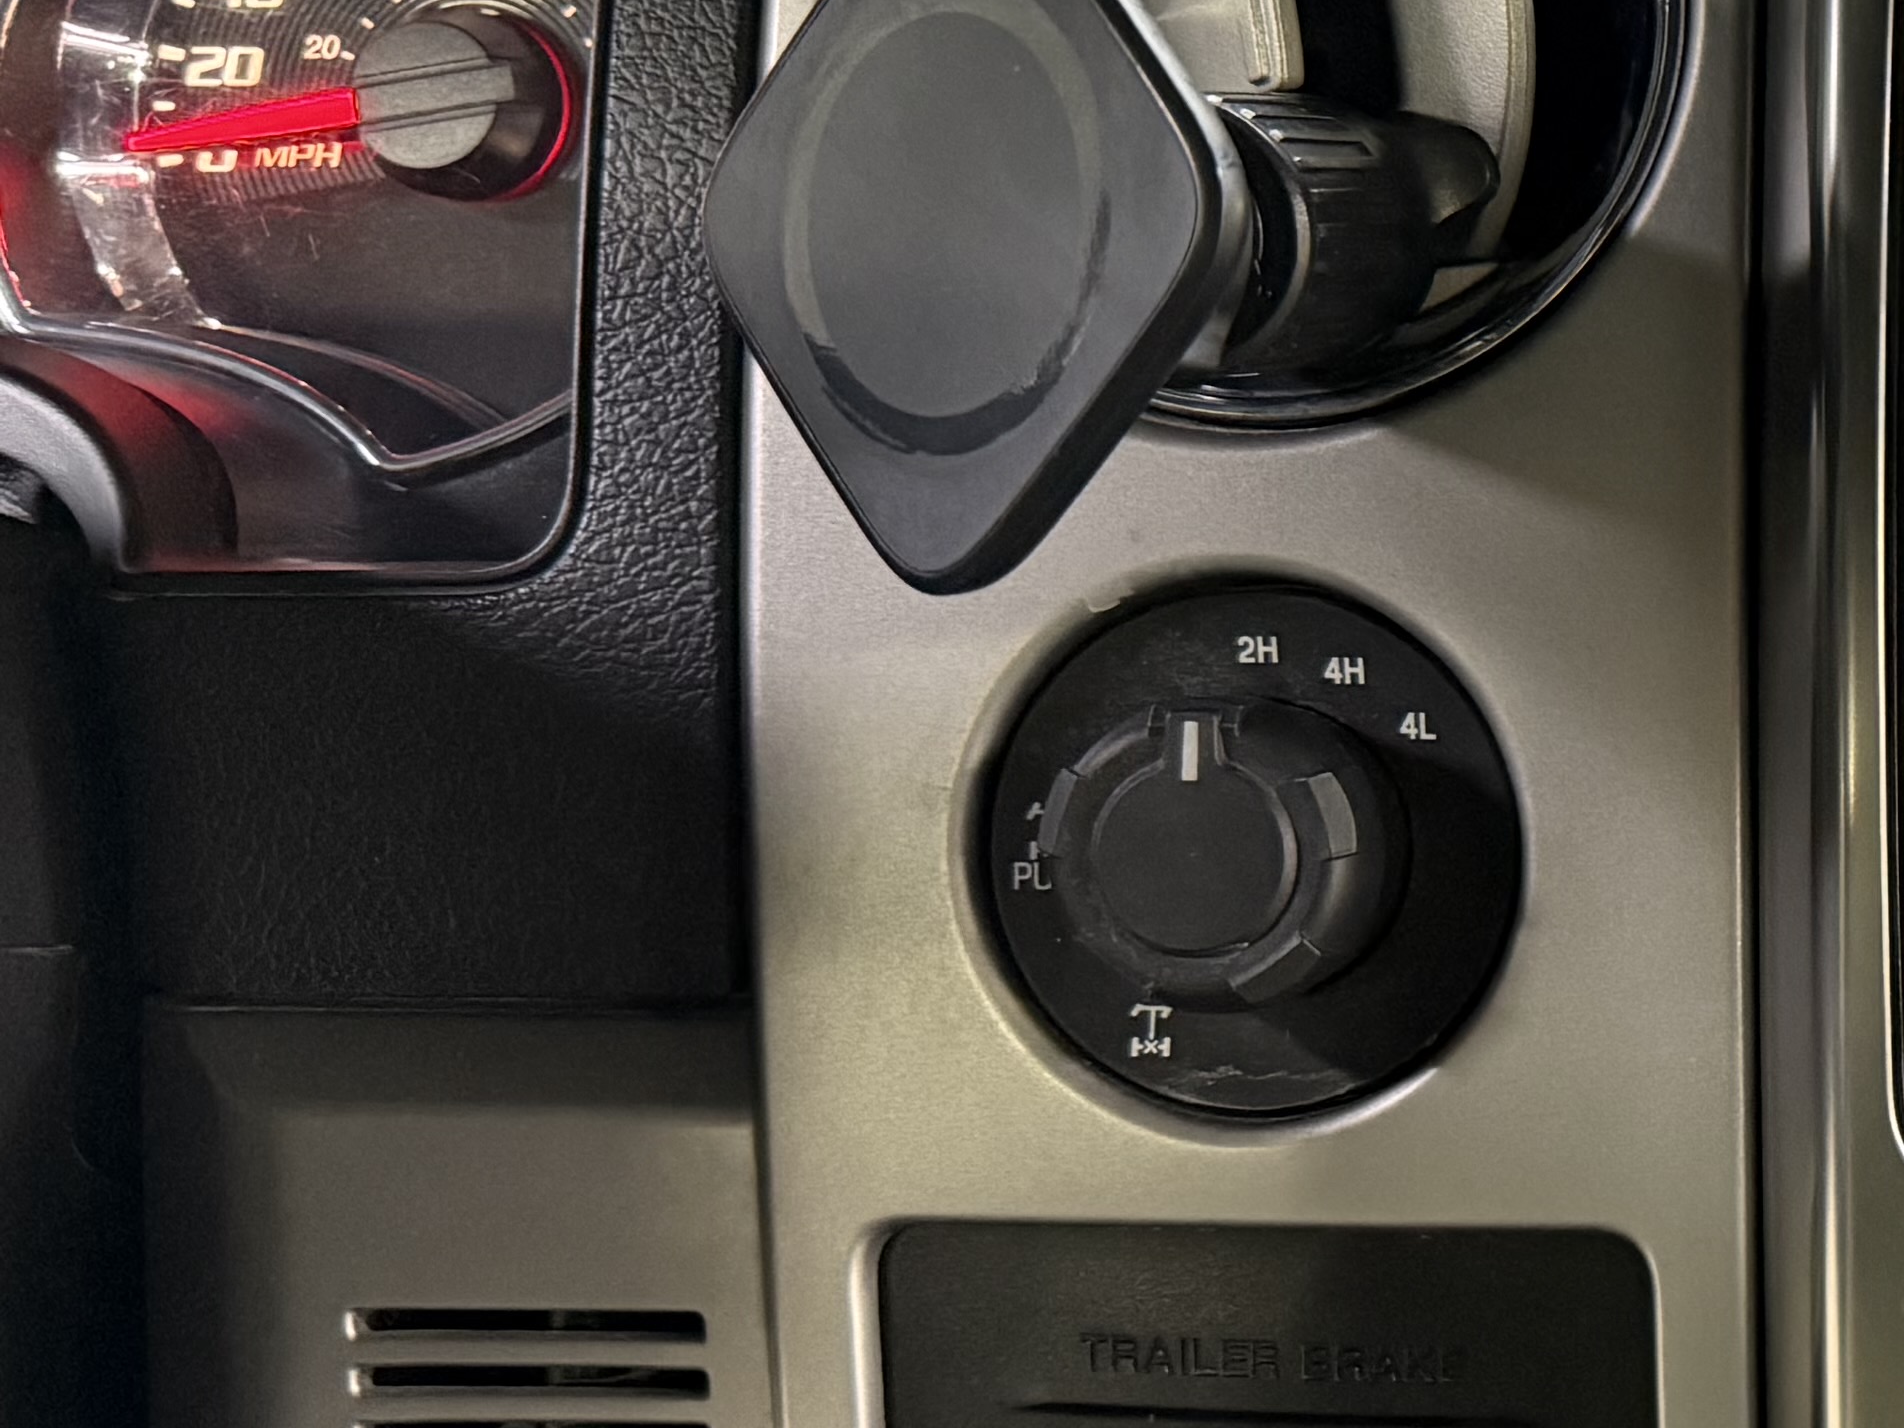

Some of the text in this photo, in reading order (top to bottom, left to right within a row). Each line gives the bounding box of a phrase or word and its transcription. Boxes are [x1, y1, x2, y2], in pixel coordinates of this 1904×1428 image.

[303, 34, 342, 61] 20
[184, 45, 265, 88] 20
[254, 141, 343, 168] MPH
[1237, 636, 1279, 665] 2H
[1323, 657, 1366, 685] 4H
[1399, 712, 1437, 741] 4L
[1080, 1332, 1280, 1378] TRAILER
